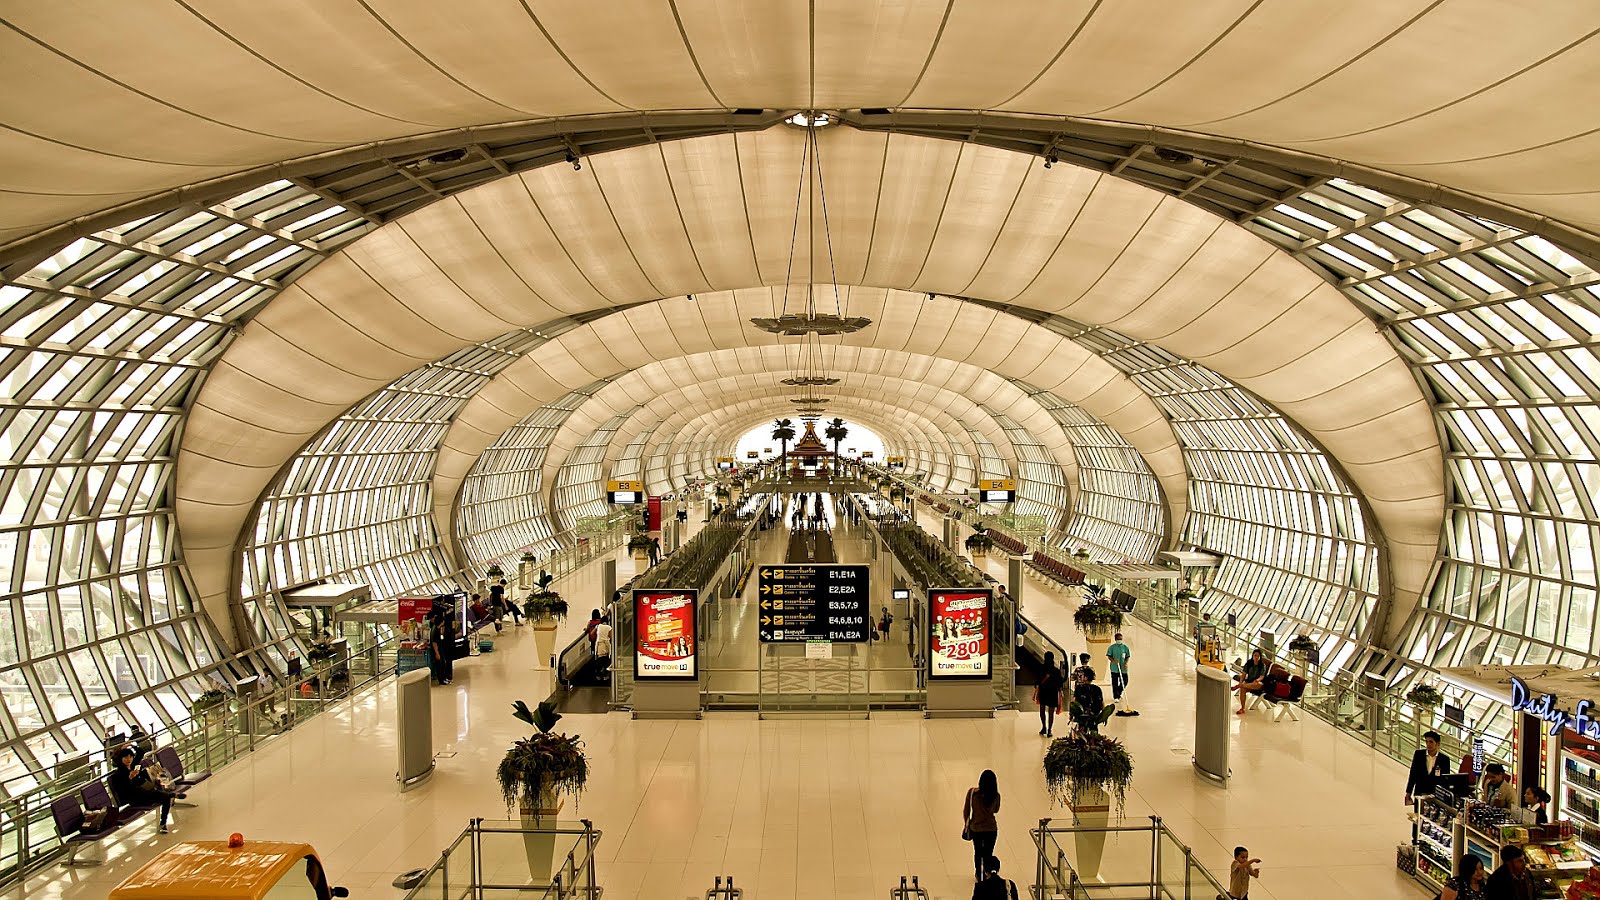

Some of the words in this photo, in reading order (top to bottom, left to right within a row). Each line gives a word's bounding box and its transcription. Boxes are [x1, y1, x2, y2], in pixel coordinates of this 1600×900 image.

[619, 482, 630, 490] E3
[992, 481, 1003, 489] E4
[829, 570, 856, 579] E1,E1A
[828, 585, 856, 594] E2,E2A
[829, 631, 861, 640] E1A,E2A
[947, 640, 979, 658] 280
[1510, 677, 1566, 736] Duty
